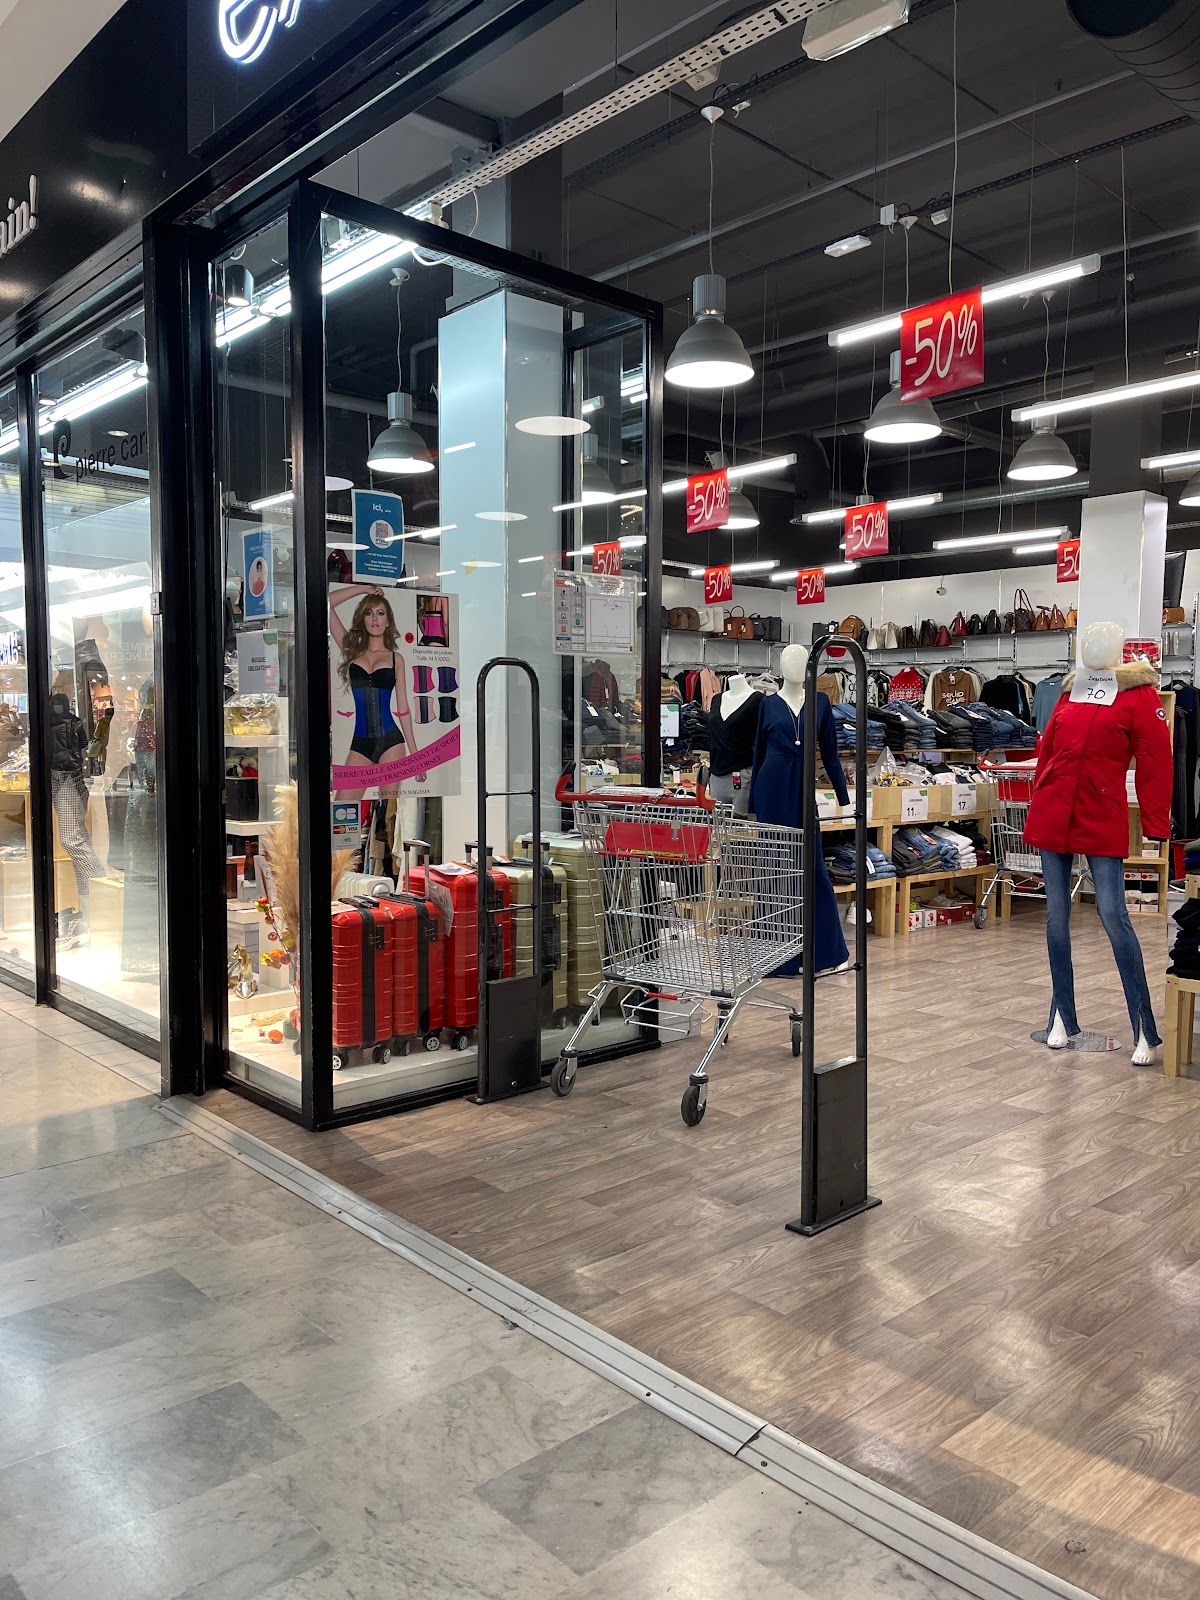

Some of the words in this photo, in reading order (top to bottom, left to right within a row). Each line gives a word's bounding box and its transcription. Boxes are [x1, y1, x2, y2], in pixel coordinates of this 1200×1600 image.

[905, 304, 978, 386] -50%
[76, 445, 116, 485] pierre
[121, 431, 149, 462] car
[689, 477, 726, 523] -50%
[847, 511, 885, 551] -50%
[1059, 547, 1081, 577] -50
[706, 574, 731, 598] -50%
[798, 577, 824, 601] -50%
[1087, 687, 1106, 699] 70
[334, 771, 358, 779] SERRE
[359, 766, 386, 777] TAILLE
[385, 754, 430, 771] AMINCISSANT
[440, 734, 460, 749] SPORT
[360, 776, 382, 786] WAIST
[384, 766, 417, 782] TRAINING
[416, 756, 441, 770] CORSET
[335, 807, 357, 821] CB
